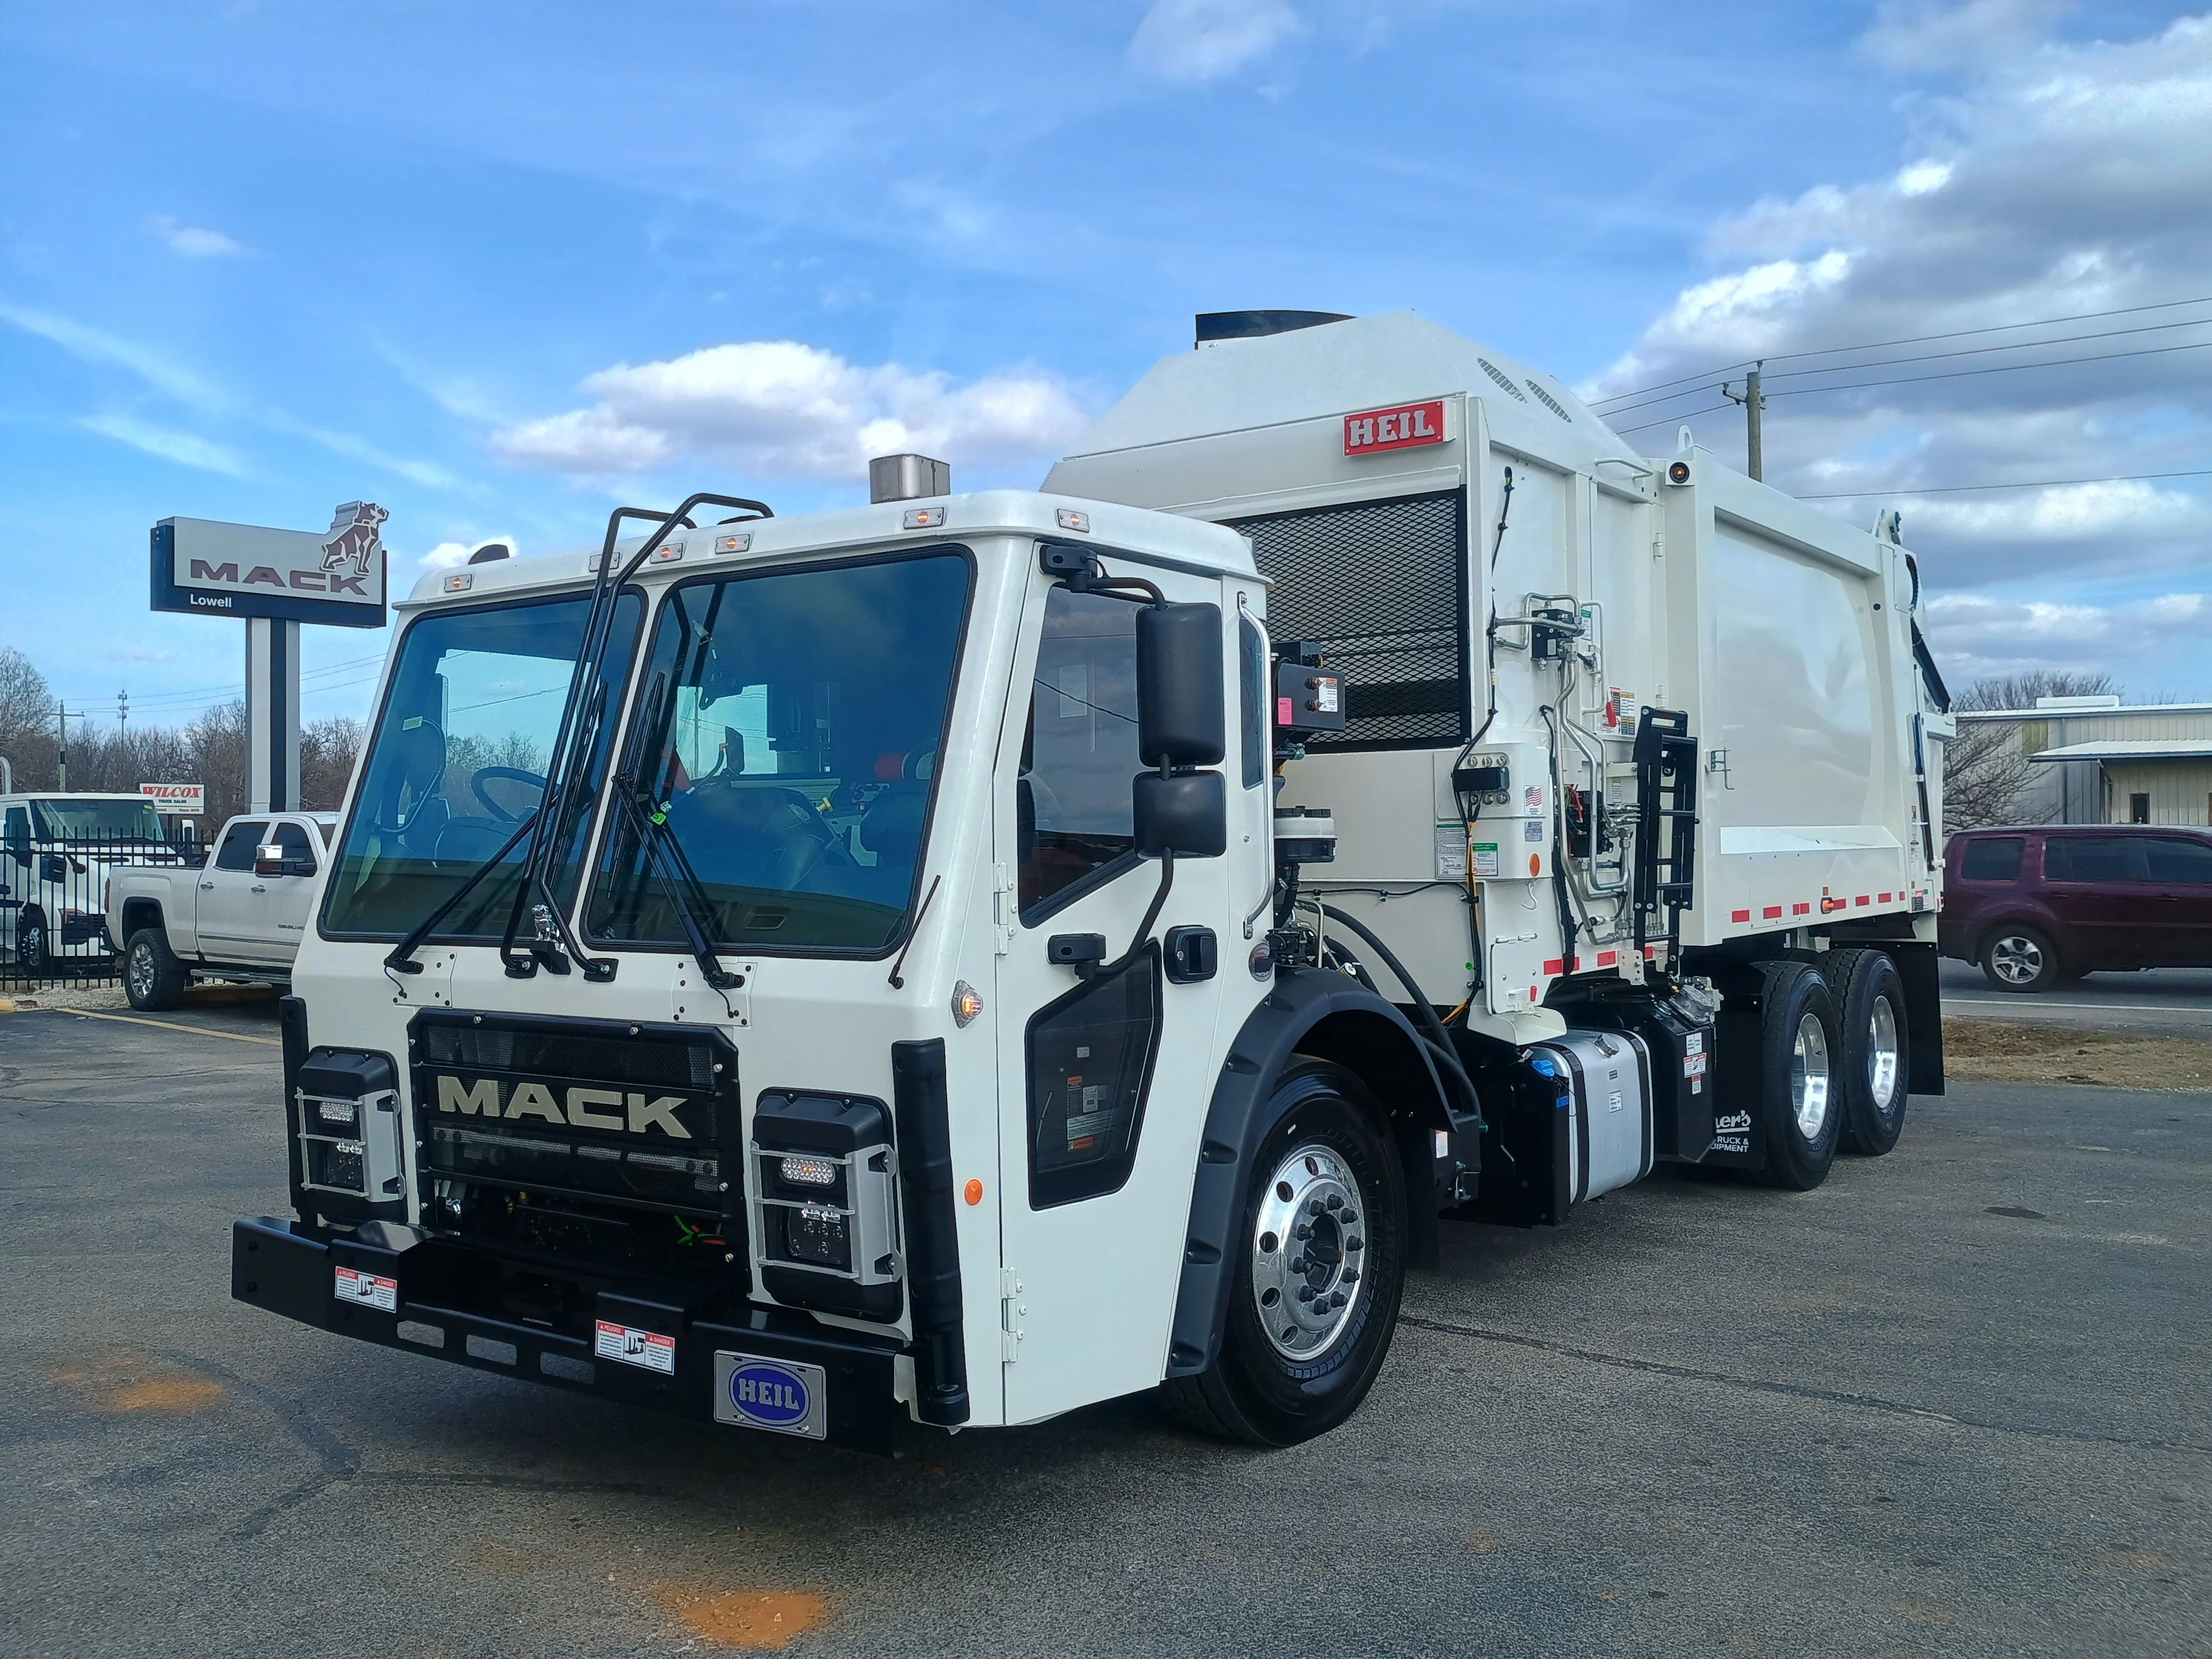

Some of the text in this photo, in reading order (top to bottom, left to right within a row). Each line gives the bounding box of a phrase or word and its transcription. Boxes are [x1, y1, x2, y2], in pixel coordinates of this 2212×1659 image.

[1350, 410, 1435, 446] HEIL
[190, 559, 368, 596] MACK
[190, 594, 232, 607] Lowell
[143, 787, 201, 798] WILCOX
[437, 1075, 692, 1138] MACK
[1717, 1136, 1741, 1144] RUCK
[604, 1325, 621, 1333] PELIGRO
[653, 1337, 670, 1345] DANGER
[738, 1378, 800, 1410] HEIL
